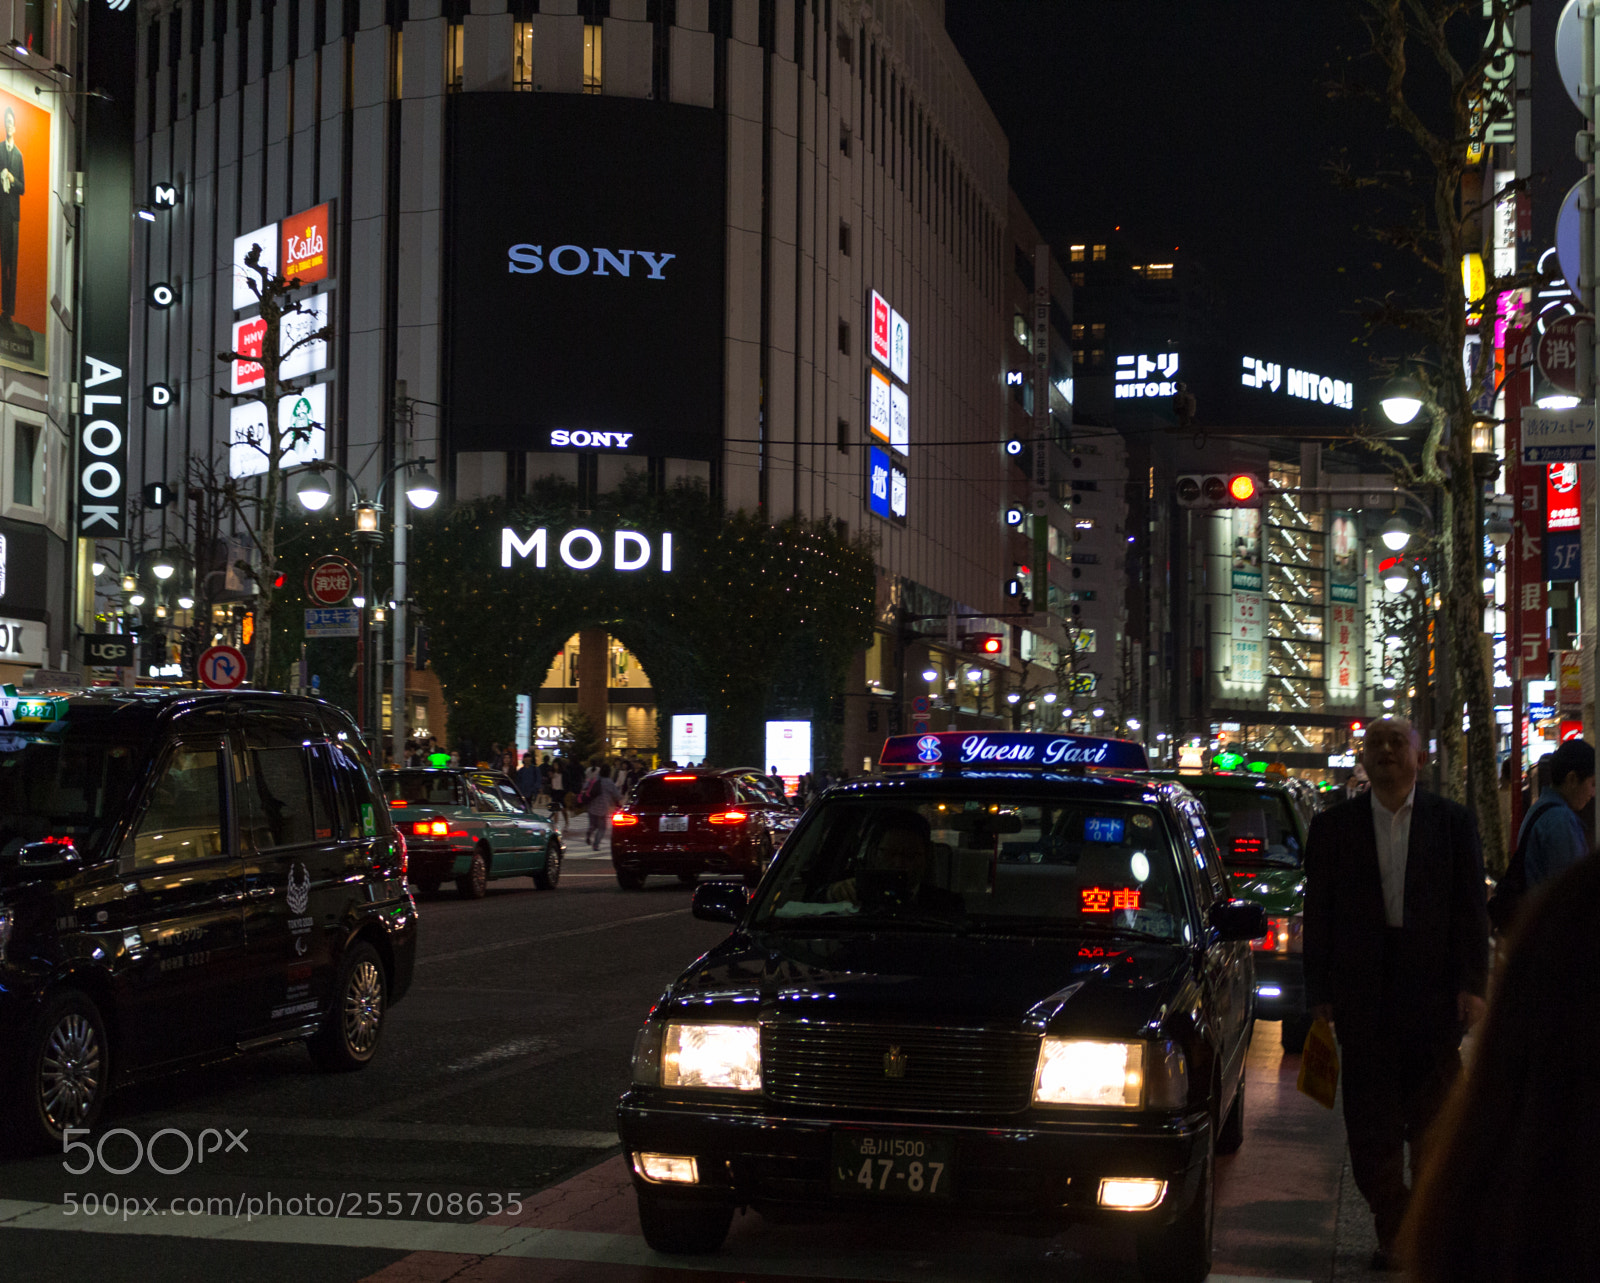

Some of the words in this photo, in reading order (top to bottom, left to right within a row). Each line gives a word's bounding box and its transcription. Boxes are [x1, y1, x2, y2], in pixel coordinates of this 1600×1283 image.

[287, 225, 324, 263] Kaila
[508, 243, 676, 280] SONY
[153, 186, 175, 505] MODI
[243, 329, 264, 346] HMV
[238, 362, 265, 379] BOOK
[1115, 353, 1179, 380] ニトリ
[1242, 356, 1281, 393] ニトリ
[1287, 368, 1353, 410] NITORI
[82, 355, 123, 531] ALOOK
[550, 429, 634, 448] SONY
[501, 527, 672, 572] MODI
[1552, 544, 1580, 570] 5F
[316, 575, 349, 591] 消火栓
[91, 643, 127, 660] UGG
[20, 704, 52, 717] 9227
[960, 735, 1036, 763] Yaesu
[1042, 738, 1108, 764] Taxi
[1088, 819, 1121, 833] カード
[1093, 831, 1114, 841] OK
[1082, 887, 1141, 912] 空車
[838, 1166, 854, 1180] い
[857, 1158, 945, 1193] 47-87
